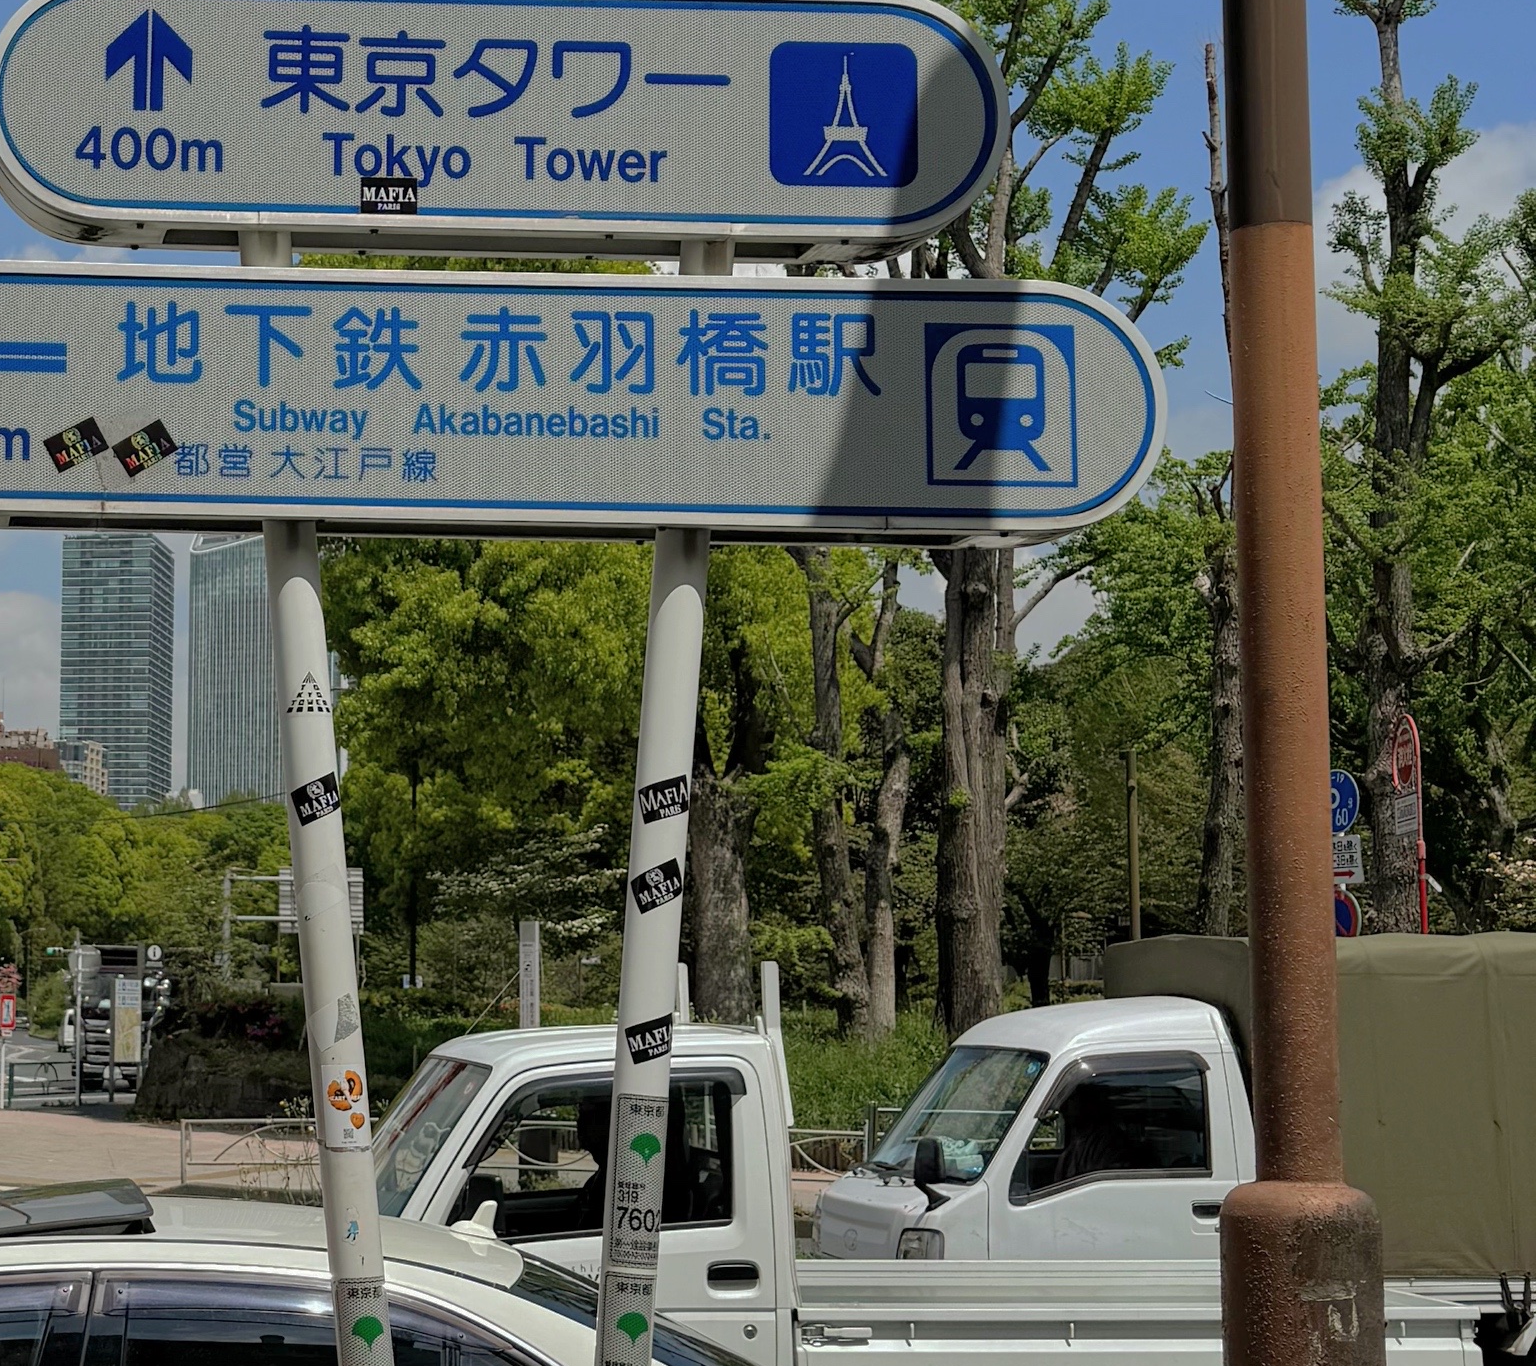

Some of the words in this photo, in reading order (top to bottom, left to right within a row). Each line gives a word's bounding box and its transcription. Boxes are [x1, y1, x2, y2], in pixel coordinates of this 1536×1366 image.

[261, 24, 731, 118] 東京タワー
[75, 125, 223, 173] 400m
[322, 132, 471, 188] Tokyo
[514, 135, 667, 183] Tower
[362, 187, 417, 202] MAFIA
[116, 300, 881, 397] 地下鉄赤羽橋駅
[233, 399, 368, 439] Subway
[414, 401, 660, 439] Akabanebashi
[703, 406, 771, 441] Sta.
[55, 435, 102, 465] MAFIA
[125, 438, 170, 469] MAFIA
[299, 790, 339, 818] MAFIA
[639, 781, 689, 815] MAFIA
[659, 804, 682, 819] PARIS
[1335, 808, 1348, 826] 60
[638, 876, 681, 906] MAFIA
[617, 1190, 639, 1203] 319
